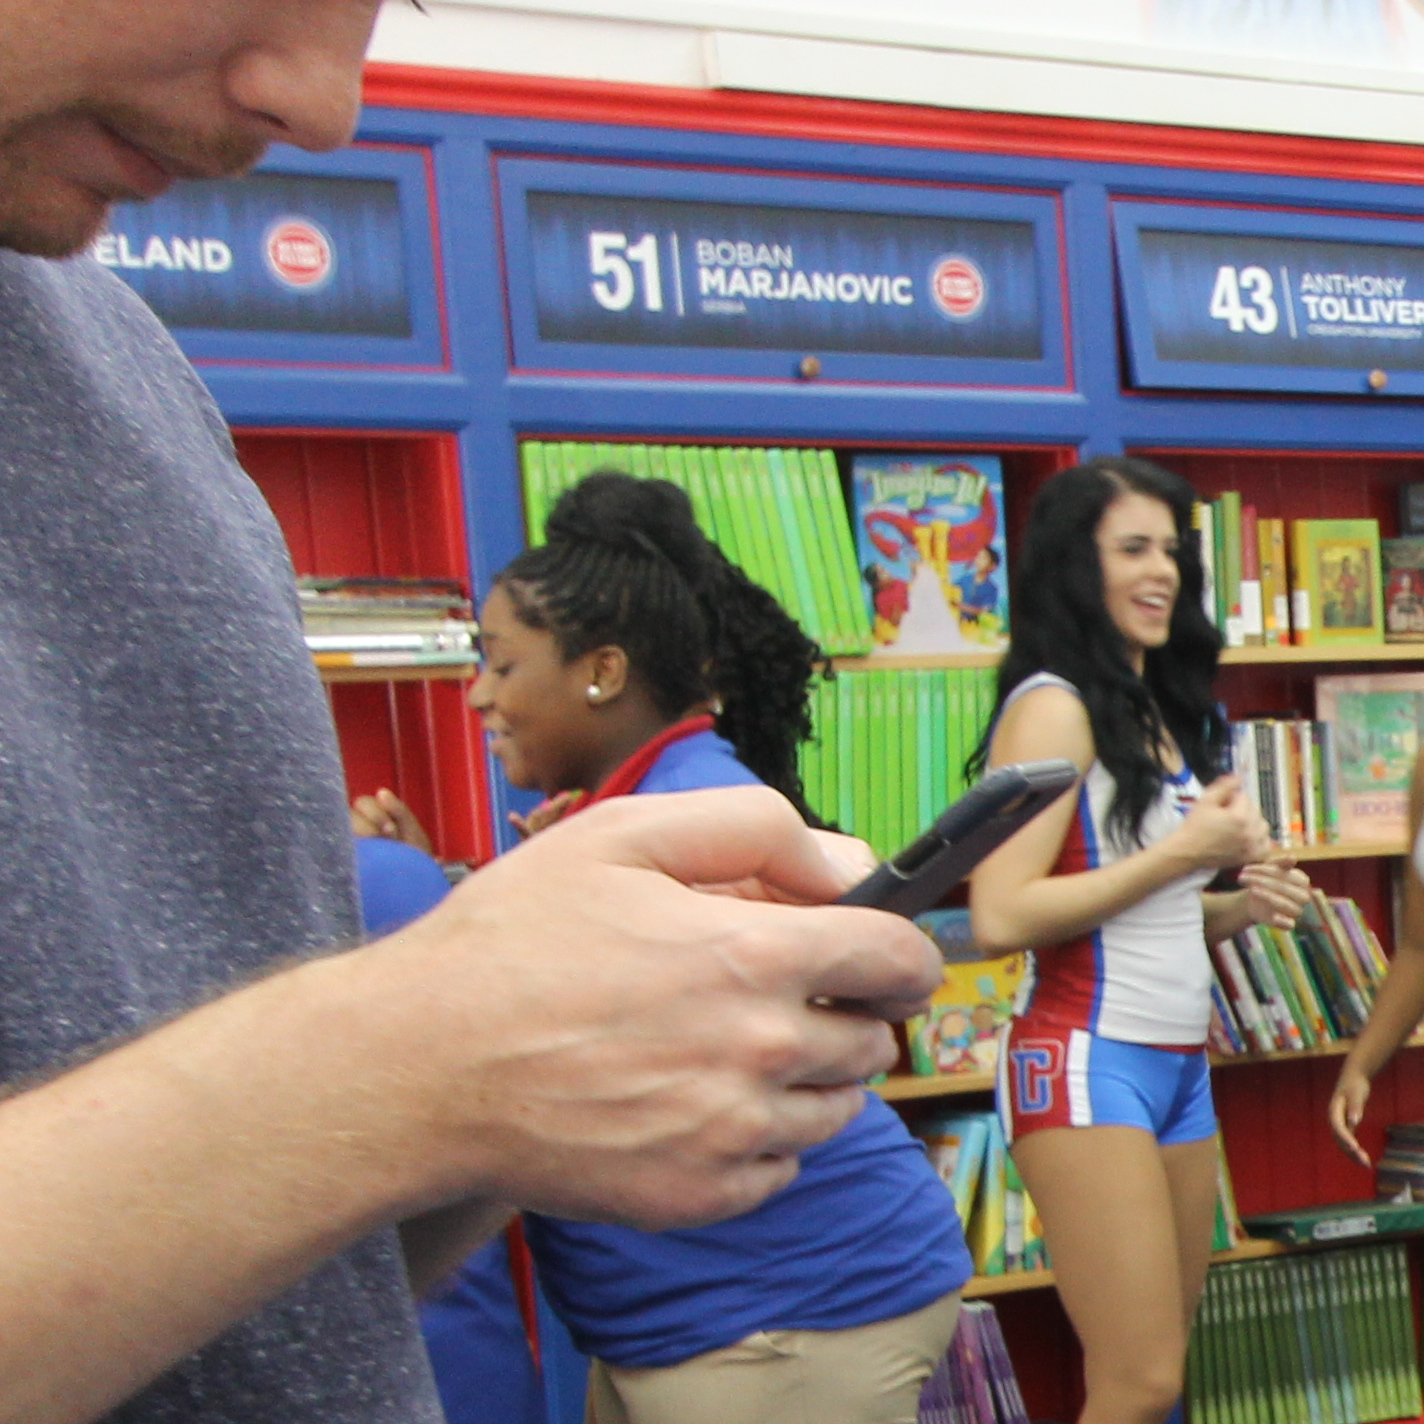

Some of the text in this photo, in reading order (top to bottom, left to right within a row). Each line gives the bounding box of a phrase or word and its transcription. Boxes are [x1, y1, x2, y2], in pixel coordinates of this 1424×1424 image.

[589, 230, 664, 312] 51
[697, 239, 794, 269] BOBAN
[699, 267, 915, 306] MARJANOVIC
[1210, 265, 1279, 335] 43
[1301, 272, 1407, 298] ANTHONY
